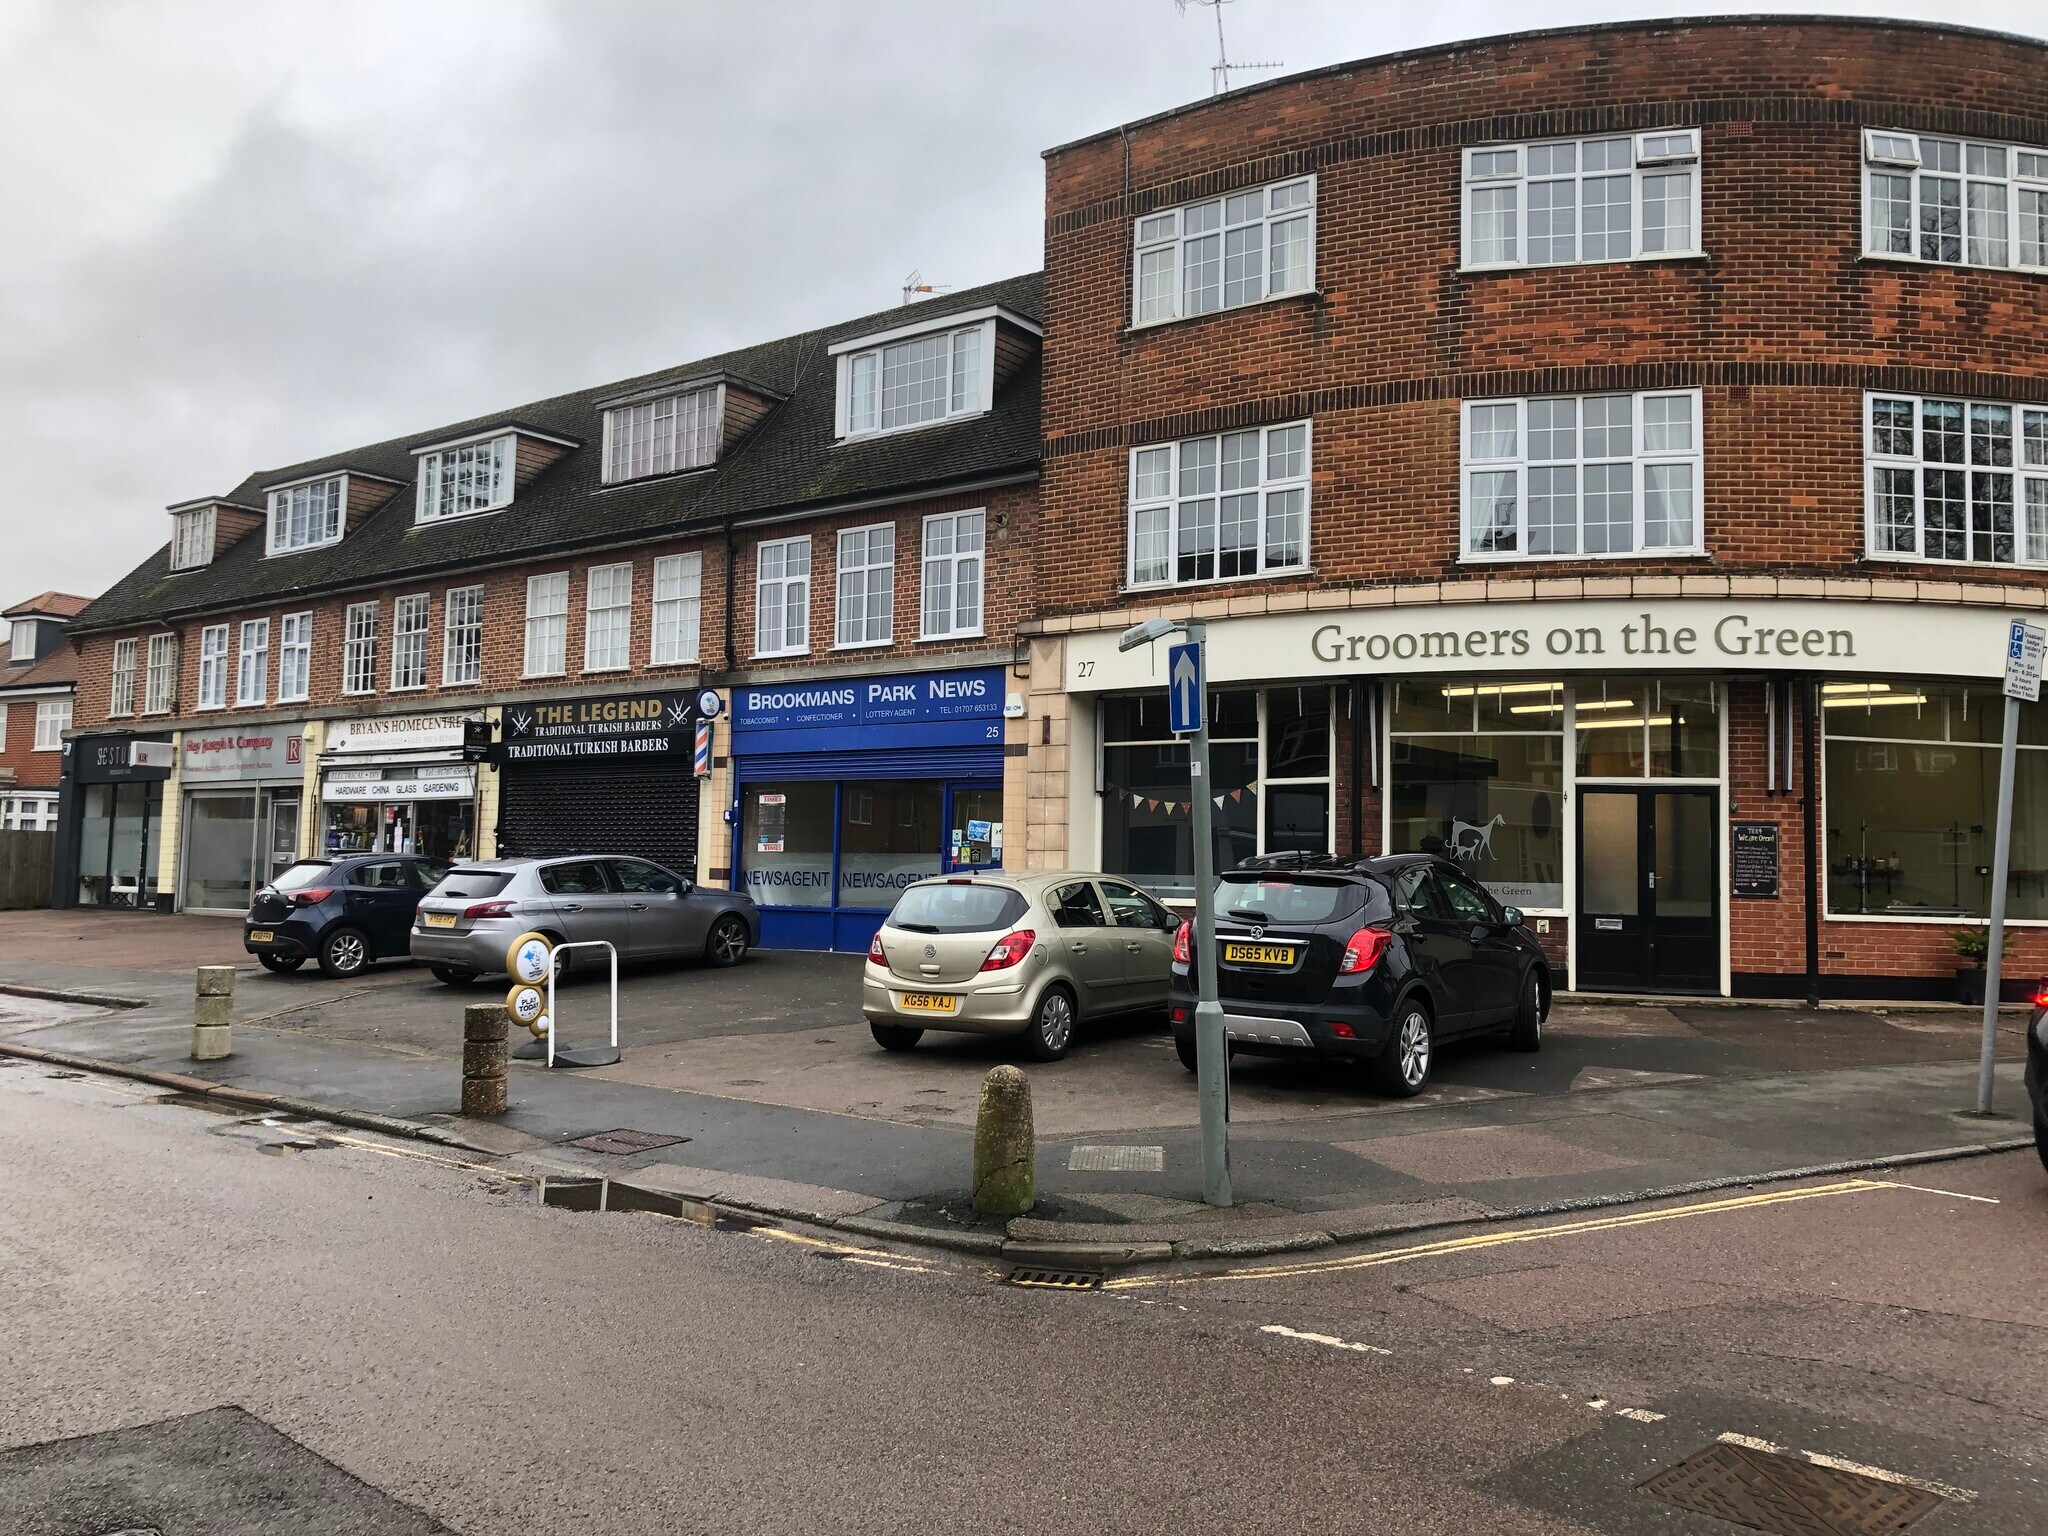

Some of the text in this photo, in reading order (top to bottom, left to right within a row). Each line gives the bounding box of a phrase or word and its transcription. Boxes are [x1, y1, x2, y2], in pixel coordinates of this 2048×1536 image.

[1311, 613, 1857, 662] Groomers on the Green
[2014, 627, 2022, 640] P
[2025, 632, 2044, 642] Disabled
[2025, 644, 2041, 653] holders
[2027, 639, 2040, 647] badge
[1078, 661, 1095, 678] 27
[2019, 677, 2032, 685] hours
[748, 679, 986, 711] BROOKMANS PARK NEWS
[535, 699, 663, 725] THE LEGEND
[740, 703, 998, 725] TOBACCONIST CONFECTIONER LOTTERY AGENT TEL: 01707 653133
[350, 715, 463, 736] BRYAN'S HOMECENTRE
[535, 720, 662, 737] TRADITIONAL TURKISH BARBERS
[986, 726, 999, 739] 25
[508, 738, 669, 758] TRADITIONAL TURKISH BARBERS
[331, 771, 364, 780] ELECTRICAL
[335, 782, 459, 795] HARDWARE CHINA GLASS GARDENING
[743, 870, 830, 887] NEWSAGENT
[1502, 886, 1532, 895] Green
[1231, 946, 1289, 962] DS65 KVB
[518, 1003, 538, 1012] TODAY
[522, 997, 536, 1005] PLAY
[903, 994, 951, 1008] KG56 YAJ
